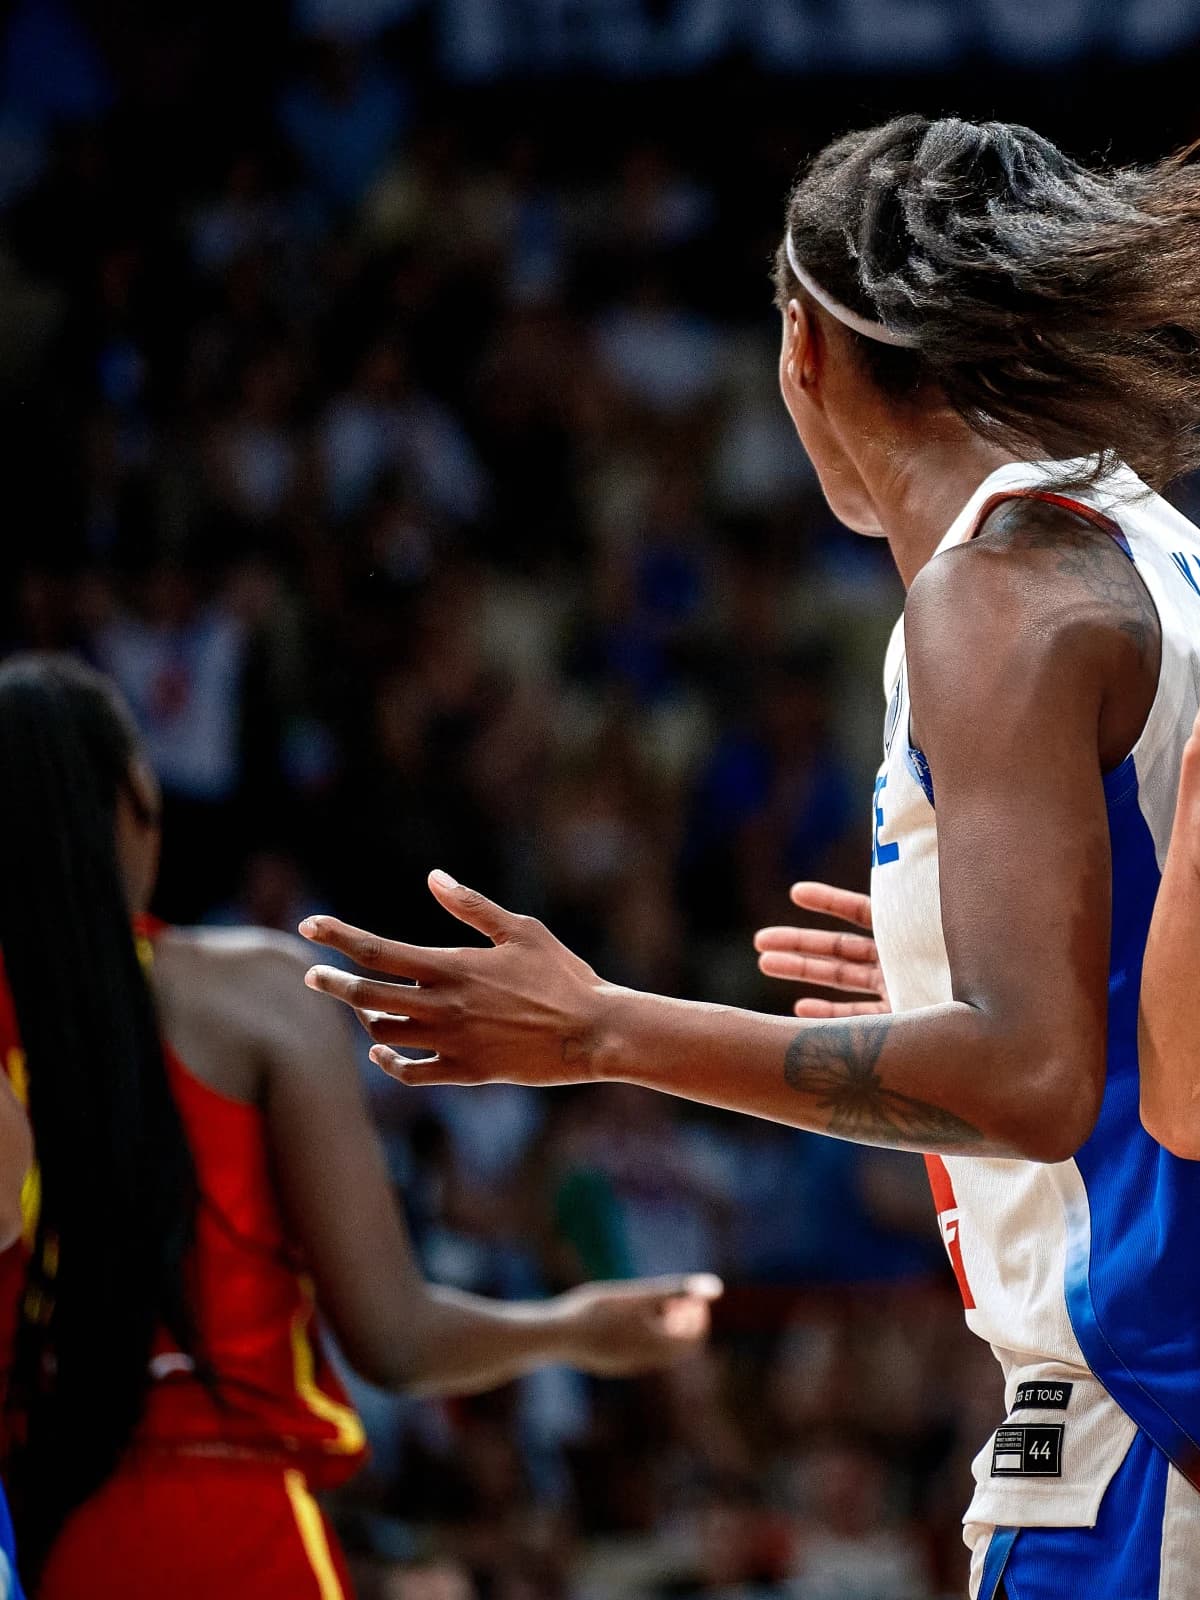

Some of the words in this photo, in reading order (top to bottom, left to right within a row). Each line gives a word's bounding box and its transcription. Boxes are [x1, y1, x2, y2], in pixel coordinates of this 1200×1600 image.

[1024, 1389, 1035, 1401] ET
[1037, 1389, 1064, 1402] TOUS
[1028, 1440, 1051, 1460] 44
